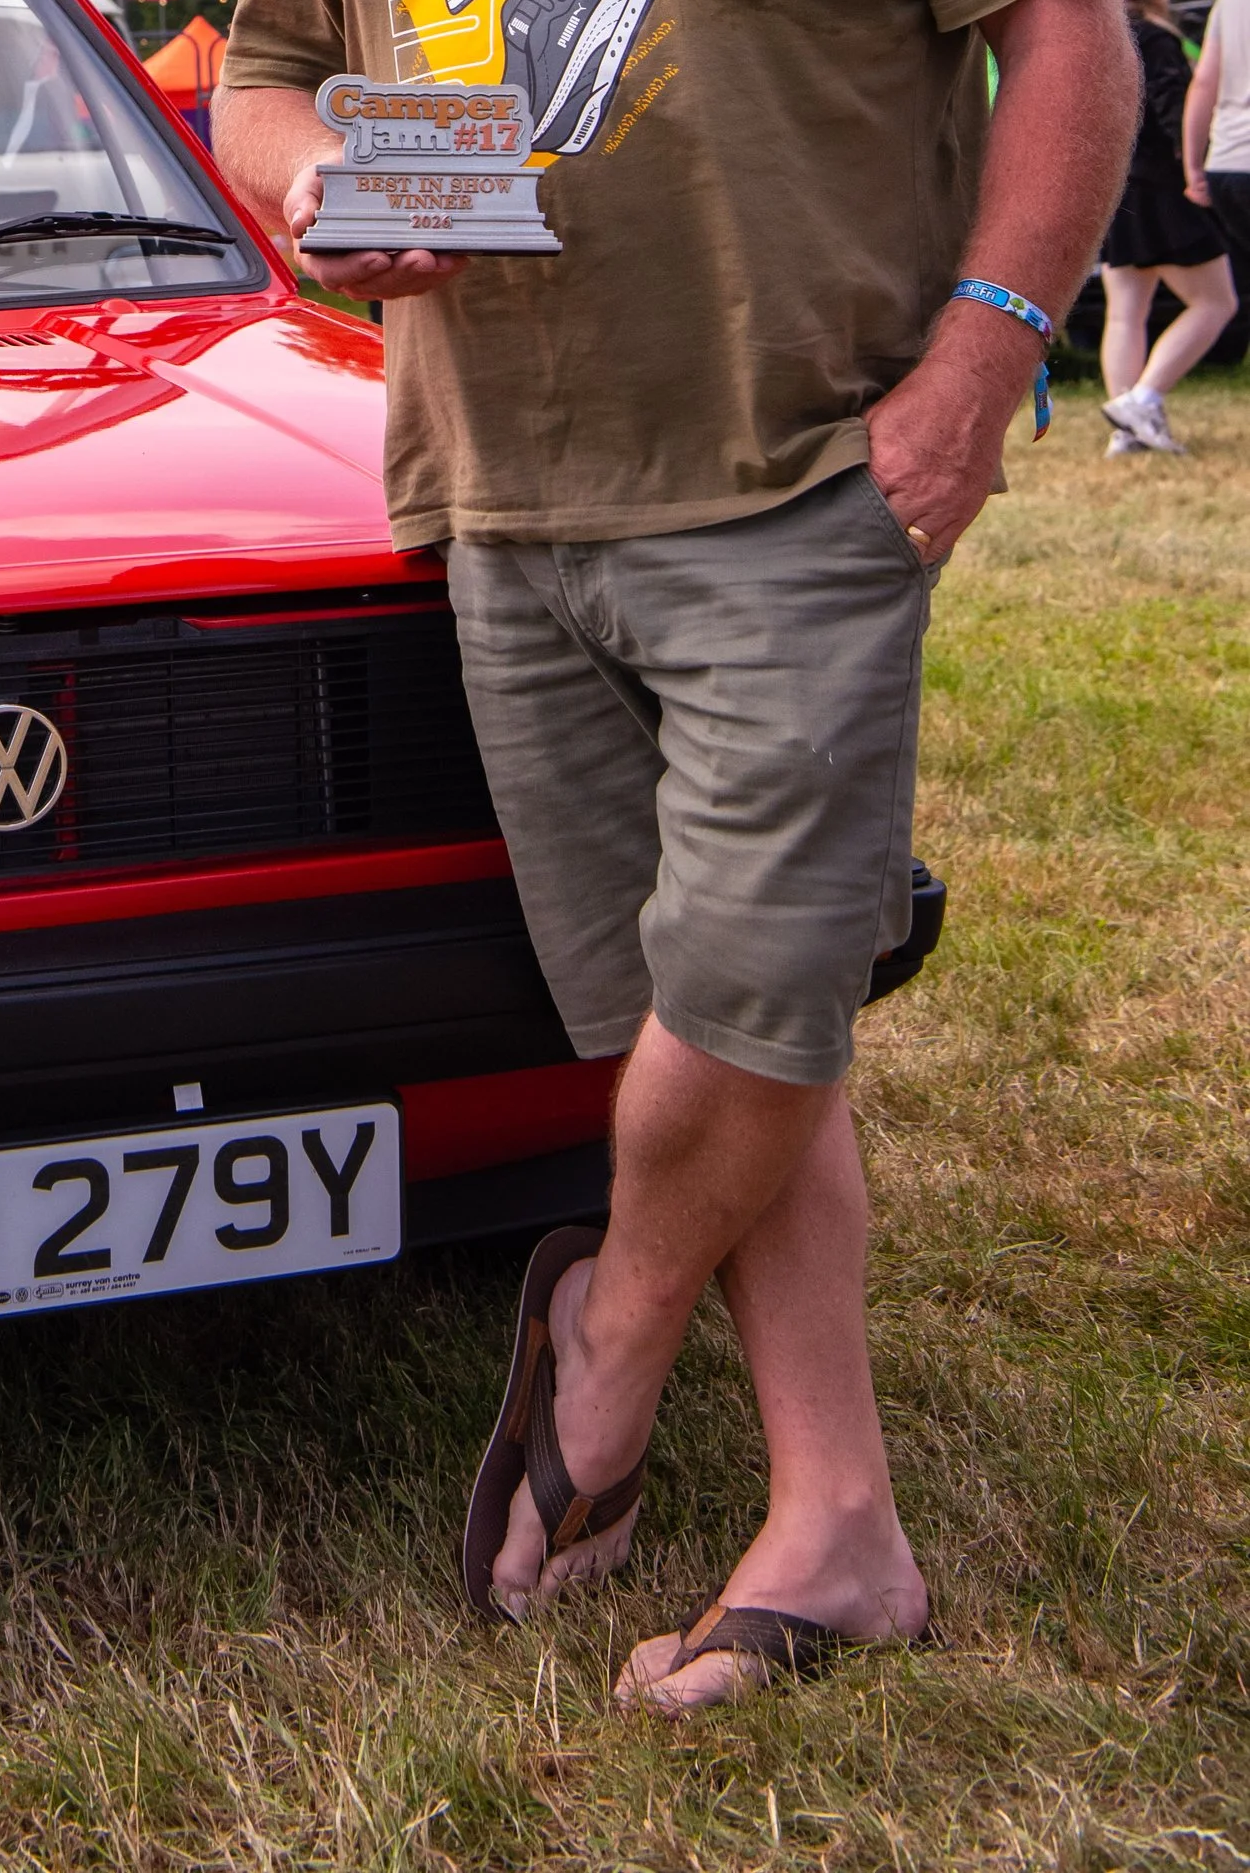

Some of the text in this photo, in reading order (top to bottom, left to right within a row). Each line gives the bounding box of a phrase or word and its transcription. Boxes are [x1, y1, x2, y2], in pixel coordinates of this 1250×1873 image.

[557, 15, 581, 48] PUMA
[330, 88, 516, 129] Camper
[353, 119, 521, 158] Jam #17
[573, 114, 595, 146] PUMA
[355, 176, 515, 194] BEST IN SHOW
[385, 194, 474, 210] WINNER
[410, 213, 452, 230] 2026
[32, 1121, 377, 1279] 279Y
[65, 1272, 141, 1290] surrey van centre
